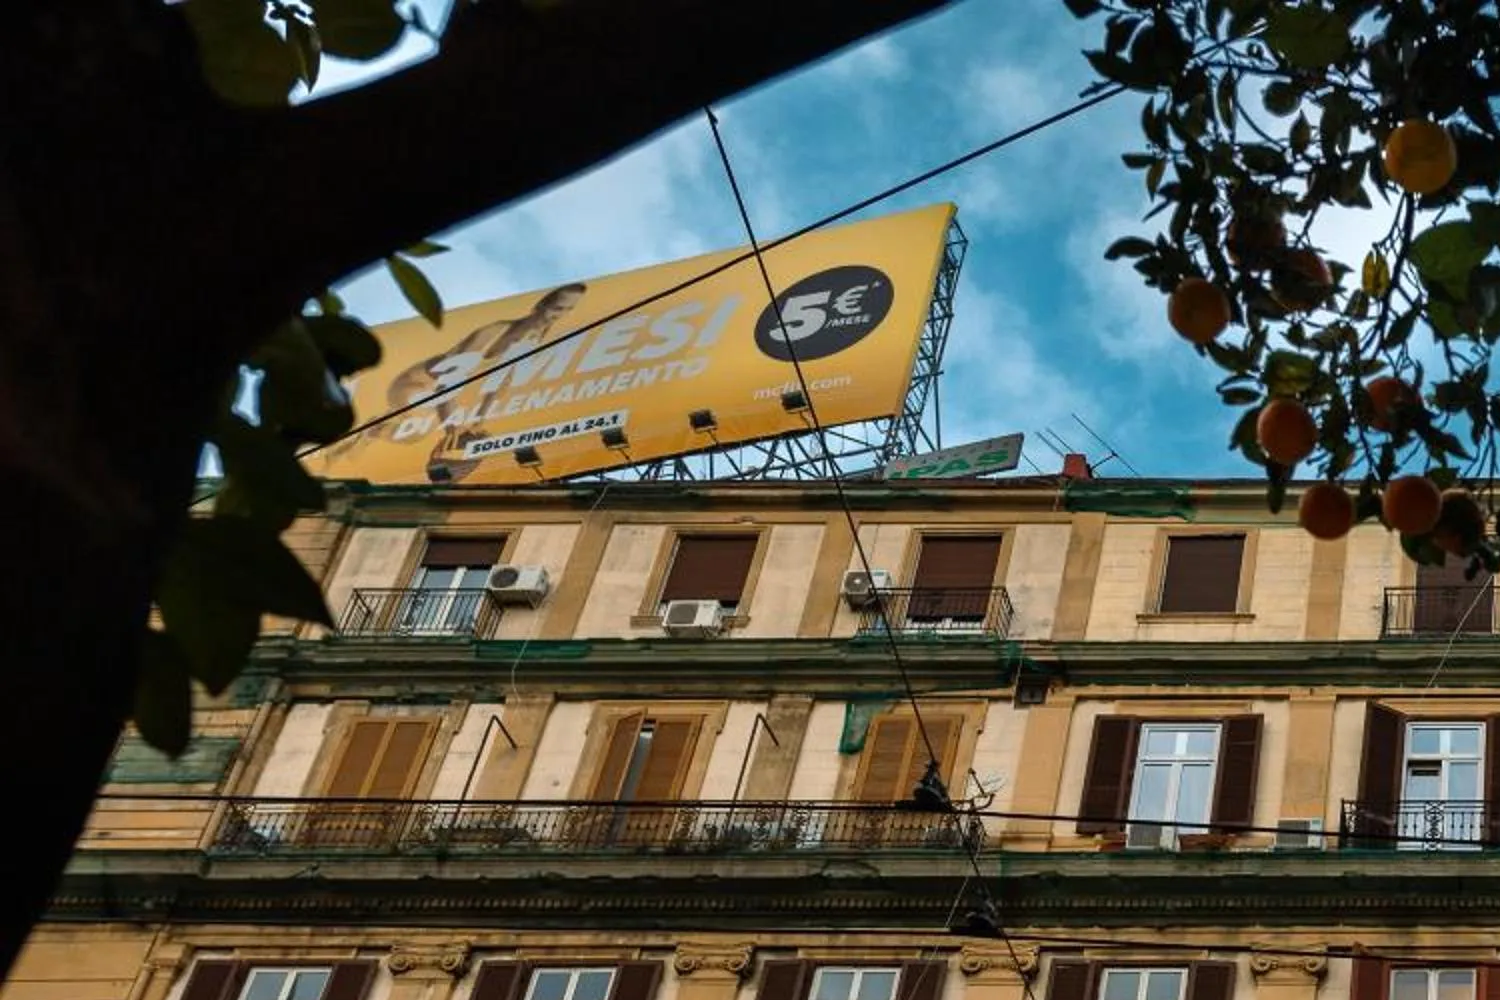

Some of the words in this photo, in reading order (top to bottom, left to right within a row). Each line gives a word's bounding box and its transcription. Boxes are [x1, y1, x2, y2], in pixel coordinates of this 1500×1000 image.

[479, 293, 743, 394] MESI
[391, 416, 433, 441] DI
[438, 356, 708, 428] ALLENAMENTO
[472, 437, 514, 455] SOLO
[518, 429, 556, 445] FINO
[560, 420, 581, 436] AL
[583, 413, 618, 431] 24.1
